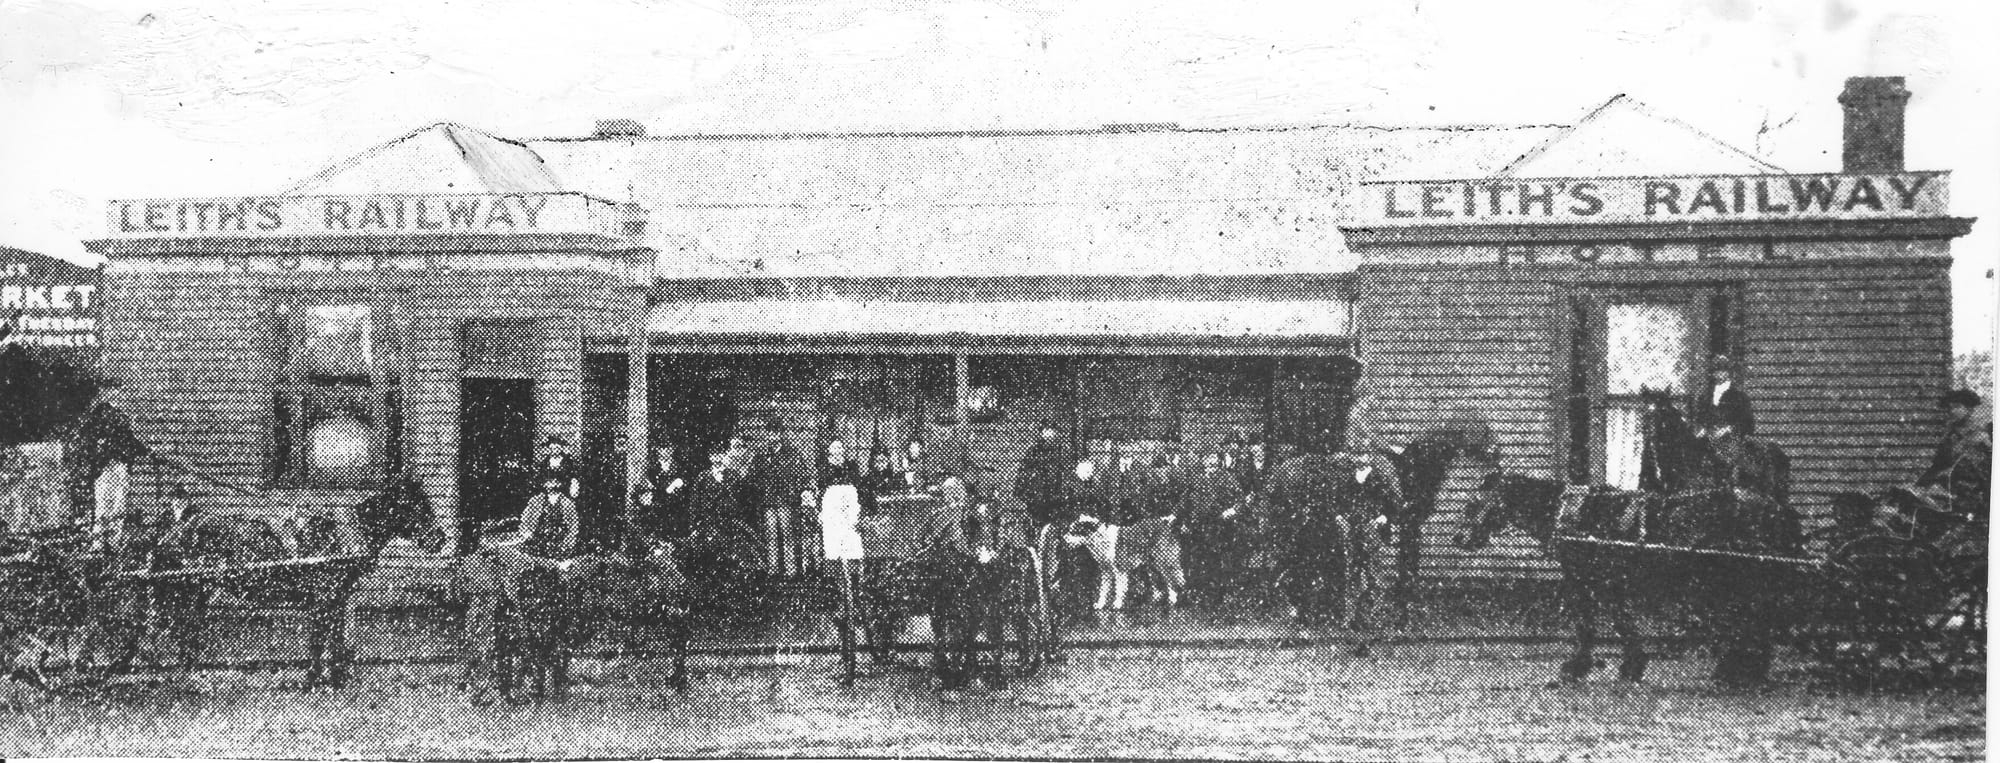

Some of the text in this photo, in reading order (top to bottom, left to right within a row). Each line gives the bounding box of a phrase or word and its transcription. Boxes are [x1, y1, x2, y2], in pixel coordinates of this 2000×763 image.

[120, 197, 547, 232] LEITH'S RAILWAY
[1384, 176, 1931, 218] LEITH'S RAILWAY
[1500, 239, 1794, 266] HOTEL
